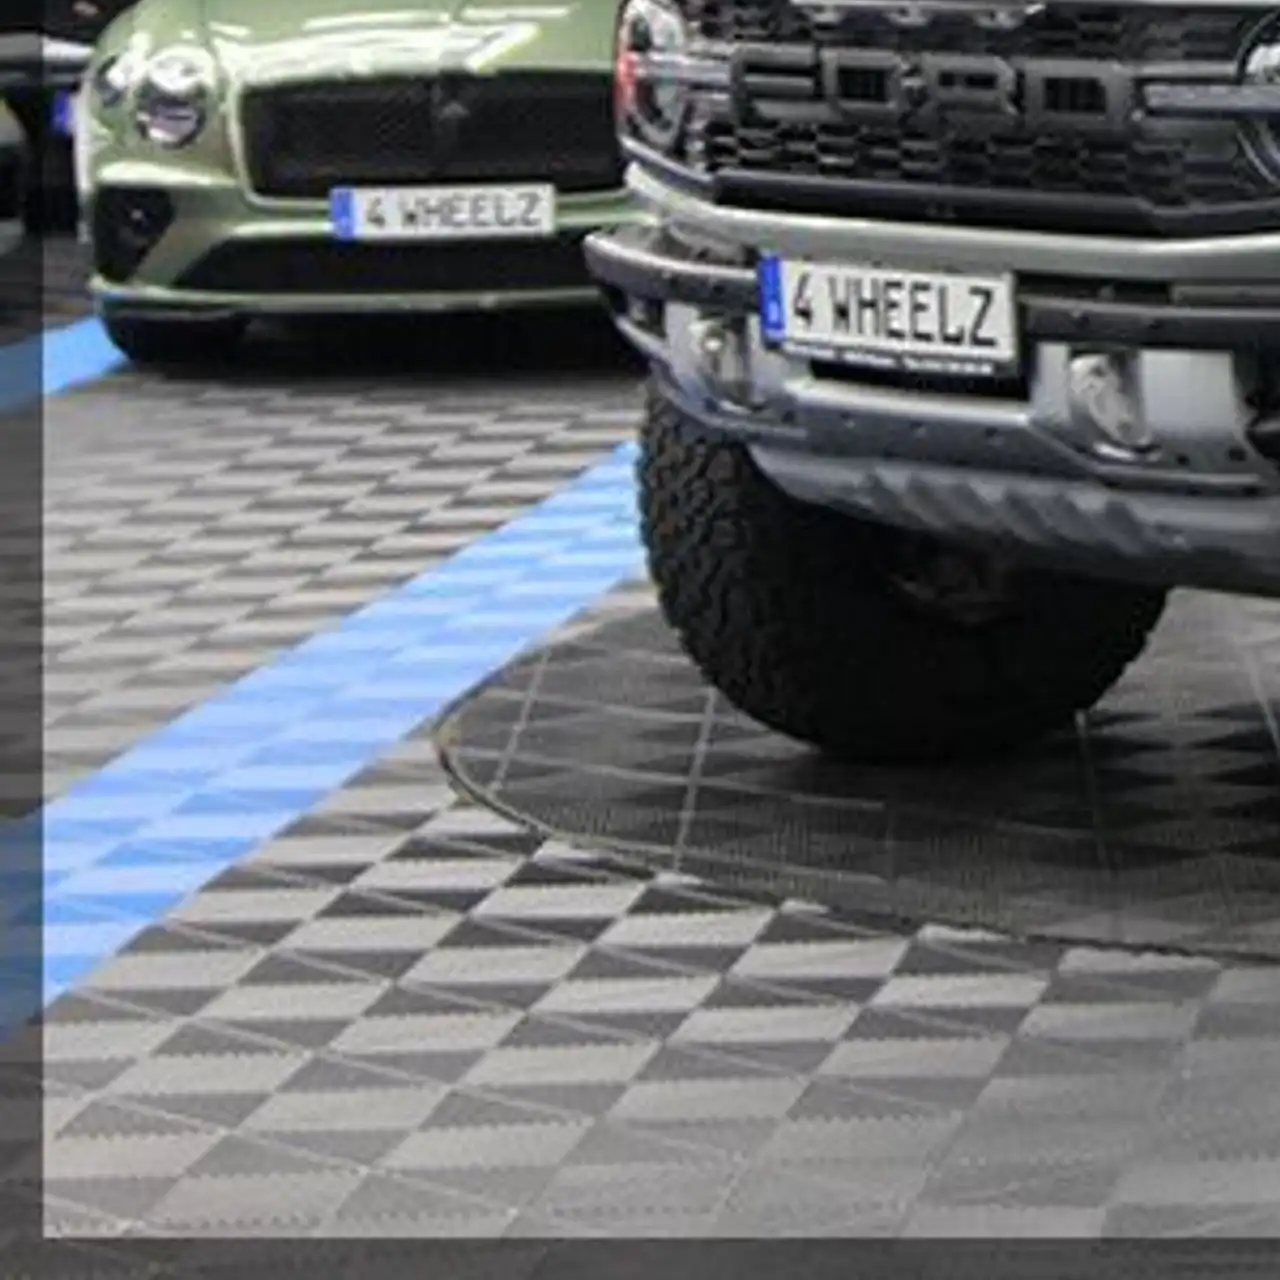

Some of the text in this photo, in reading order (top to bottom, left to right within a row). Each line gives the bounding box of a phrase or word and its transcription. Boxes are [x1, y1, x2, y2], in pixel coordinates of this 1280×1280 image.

[730, 41, 1137, 133] FORD
[366, 191, 543, 228] 4 WHEELZ
[793, 273, 997, 347] 4 WHEELZ
